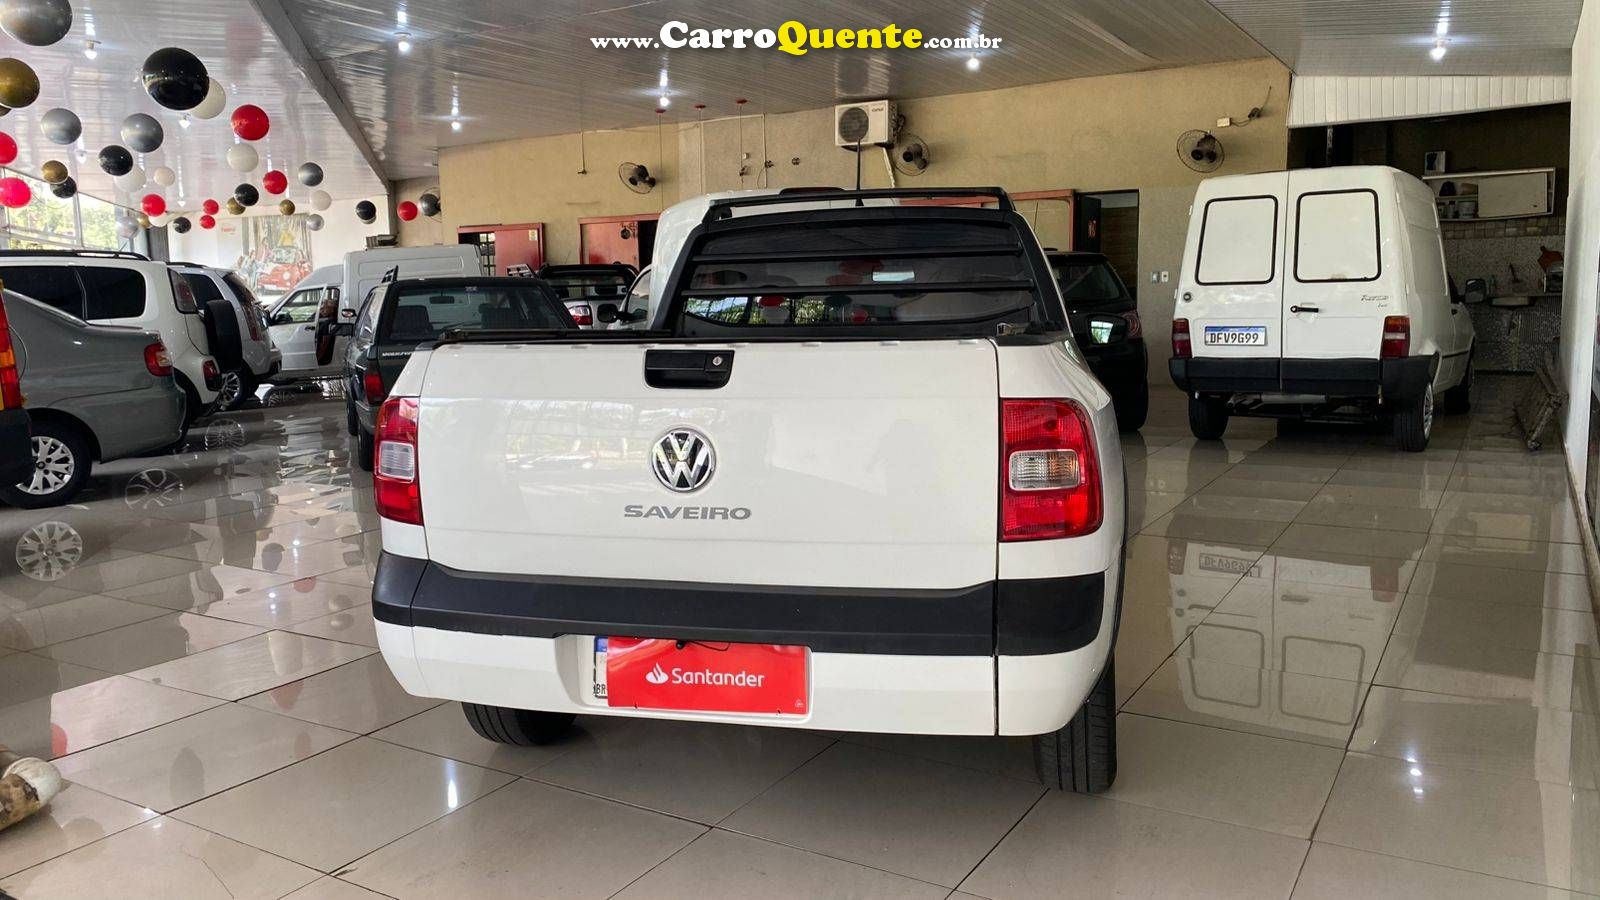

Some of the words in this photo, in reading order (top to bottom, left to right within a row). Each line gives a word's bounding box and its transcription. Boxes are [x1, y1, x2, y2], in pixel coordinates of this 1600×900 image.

[1209, 332, 1259, 344] DFV9G99
[624, 504, 752, 520] SAVEIRO
[671, 667, 765, 688] Santander
